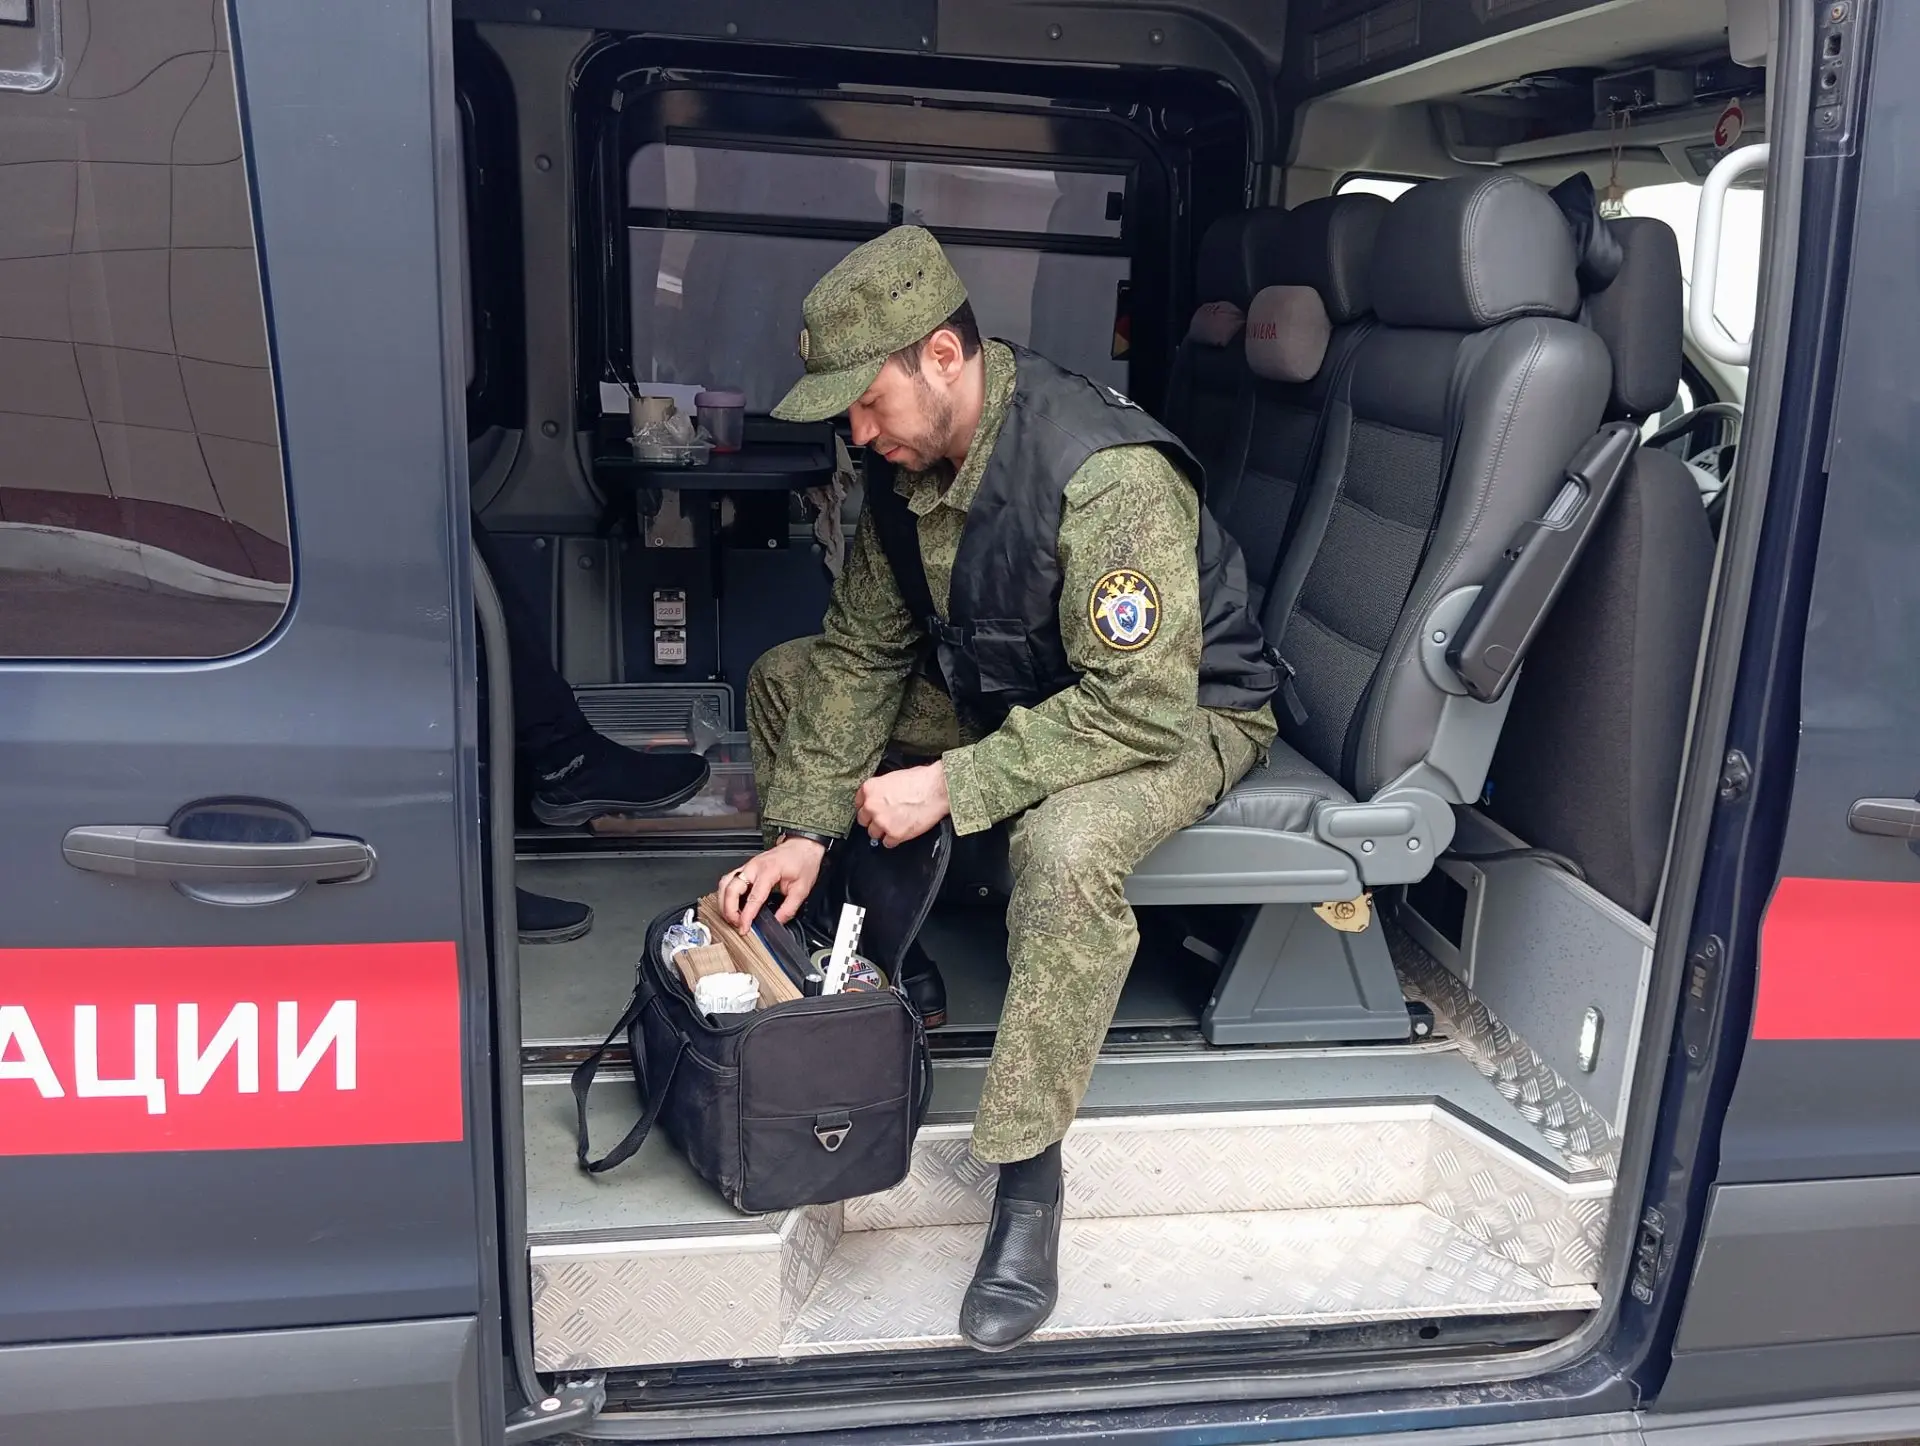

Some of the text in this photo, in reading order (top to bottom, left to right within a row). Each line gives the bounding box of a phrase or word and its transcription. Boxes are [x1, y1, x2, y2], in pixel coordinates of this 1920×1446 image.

[659, 607, 673, 615] 220
[660, 647, 674, 655] 220
[0, 1000, 357, 1114] АЦИИ
